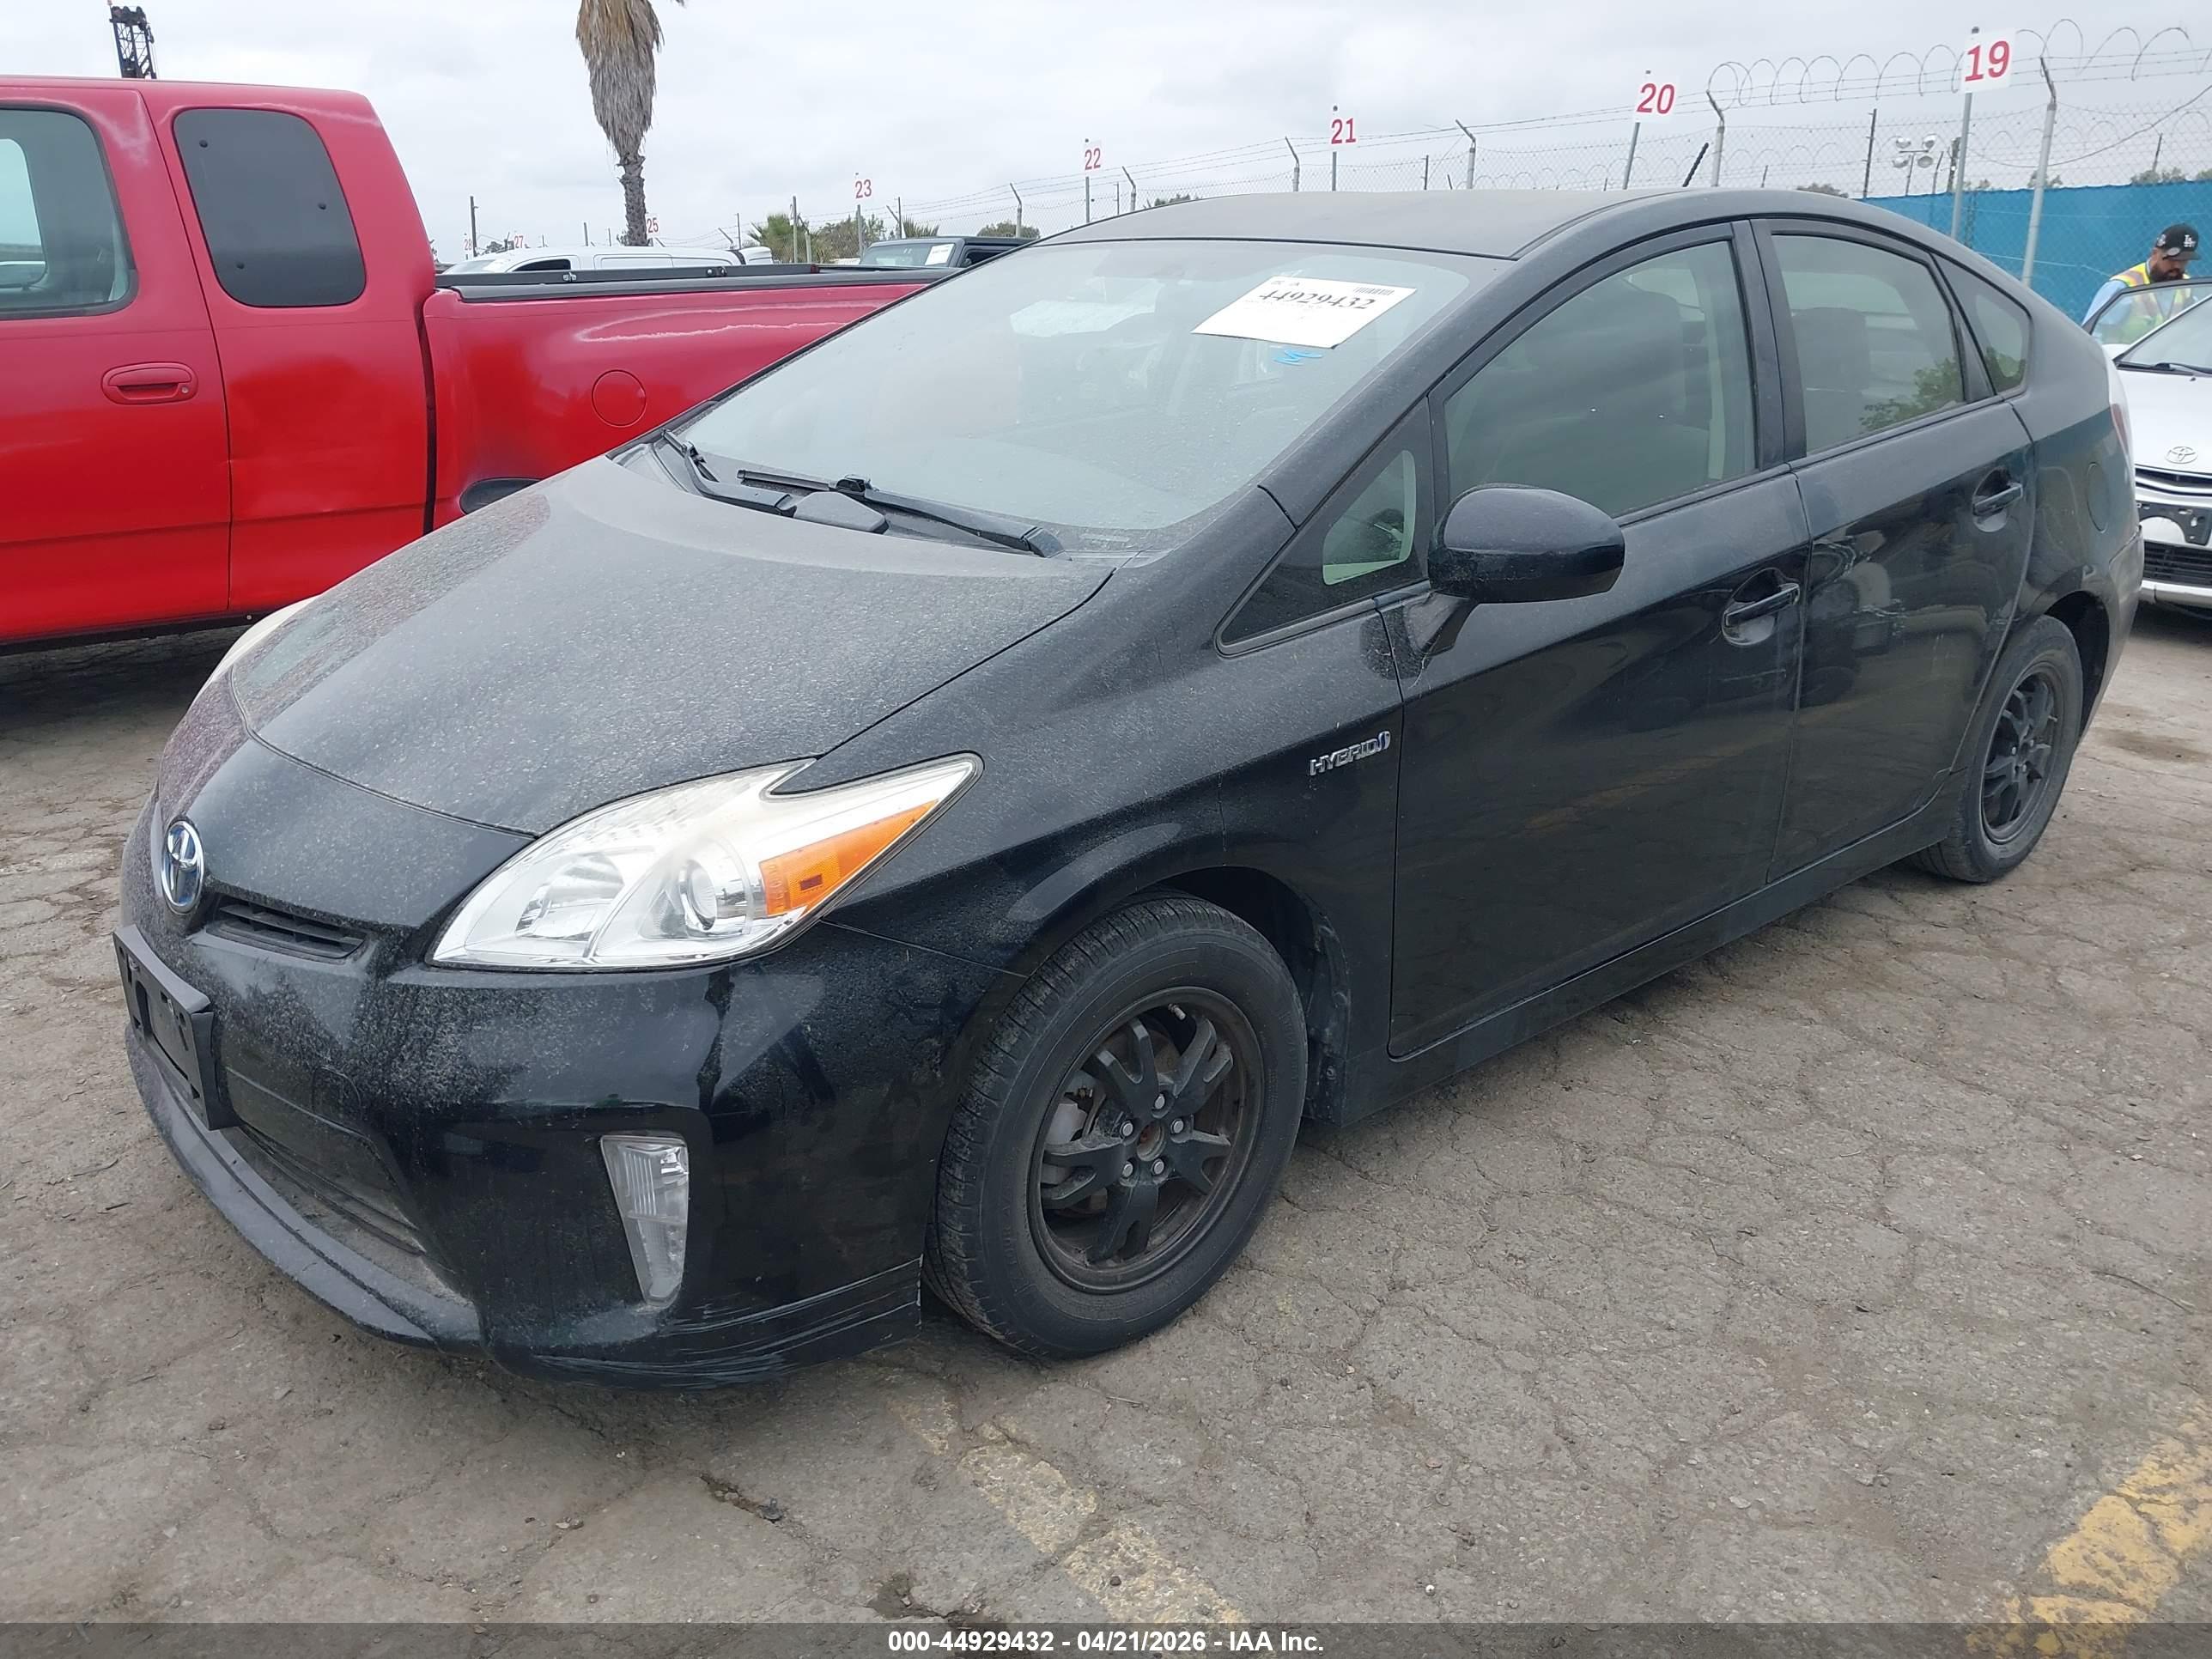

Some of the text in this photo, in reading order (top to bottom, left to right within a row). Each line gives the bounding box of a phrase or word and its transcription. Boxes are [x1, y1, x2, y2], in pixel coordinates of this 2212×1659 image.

[1965, 40, 2011, 82] 19
[1636, 82, 1675, 115] 20
[1330, 118, 1357, 145] 21
[1084, 147, 1101, 171] 22
[854, 179, 872, 199] 23
[646, 218, 659, 234] 25
[514, 234, 524, 248] 27
[2184, 234, 2197, 248] LA
[1259, 290, 1376, 310] 44929432
[1310, 732, 1389, 775] HYBRID
